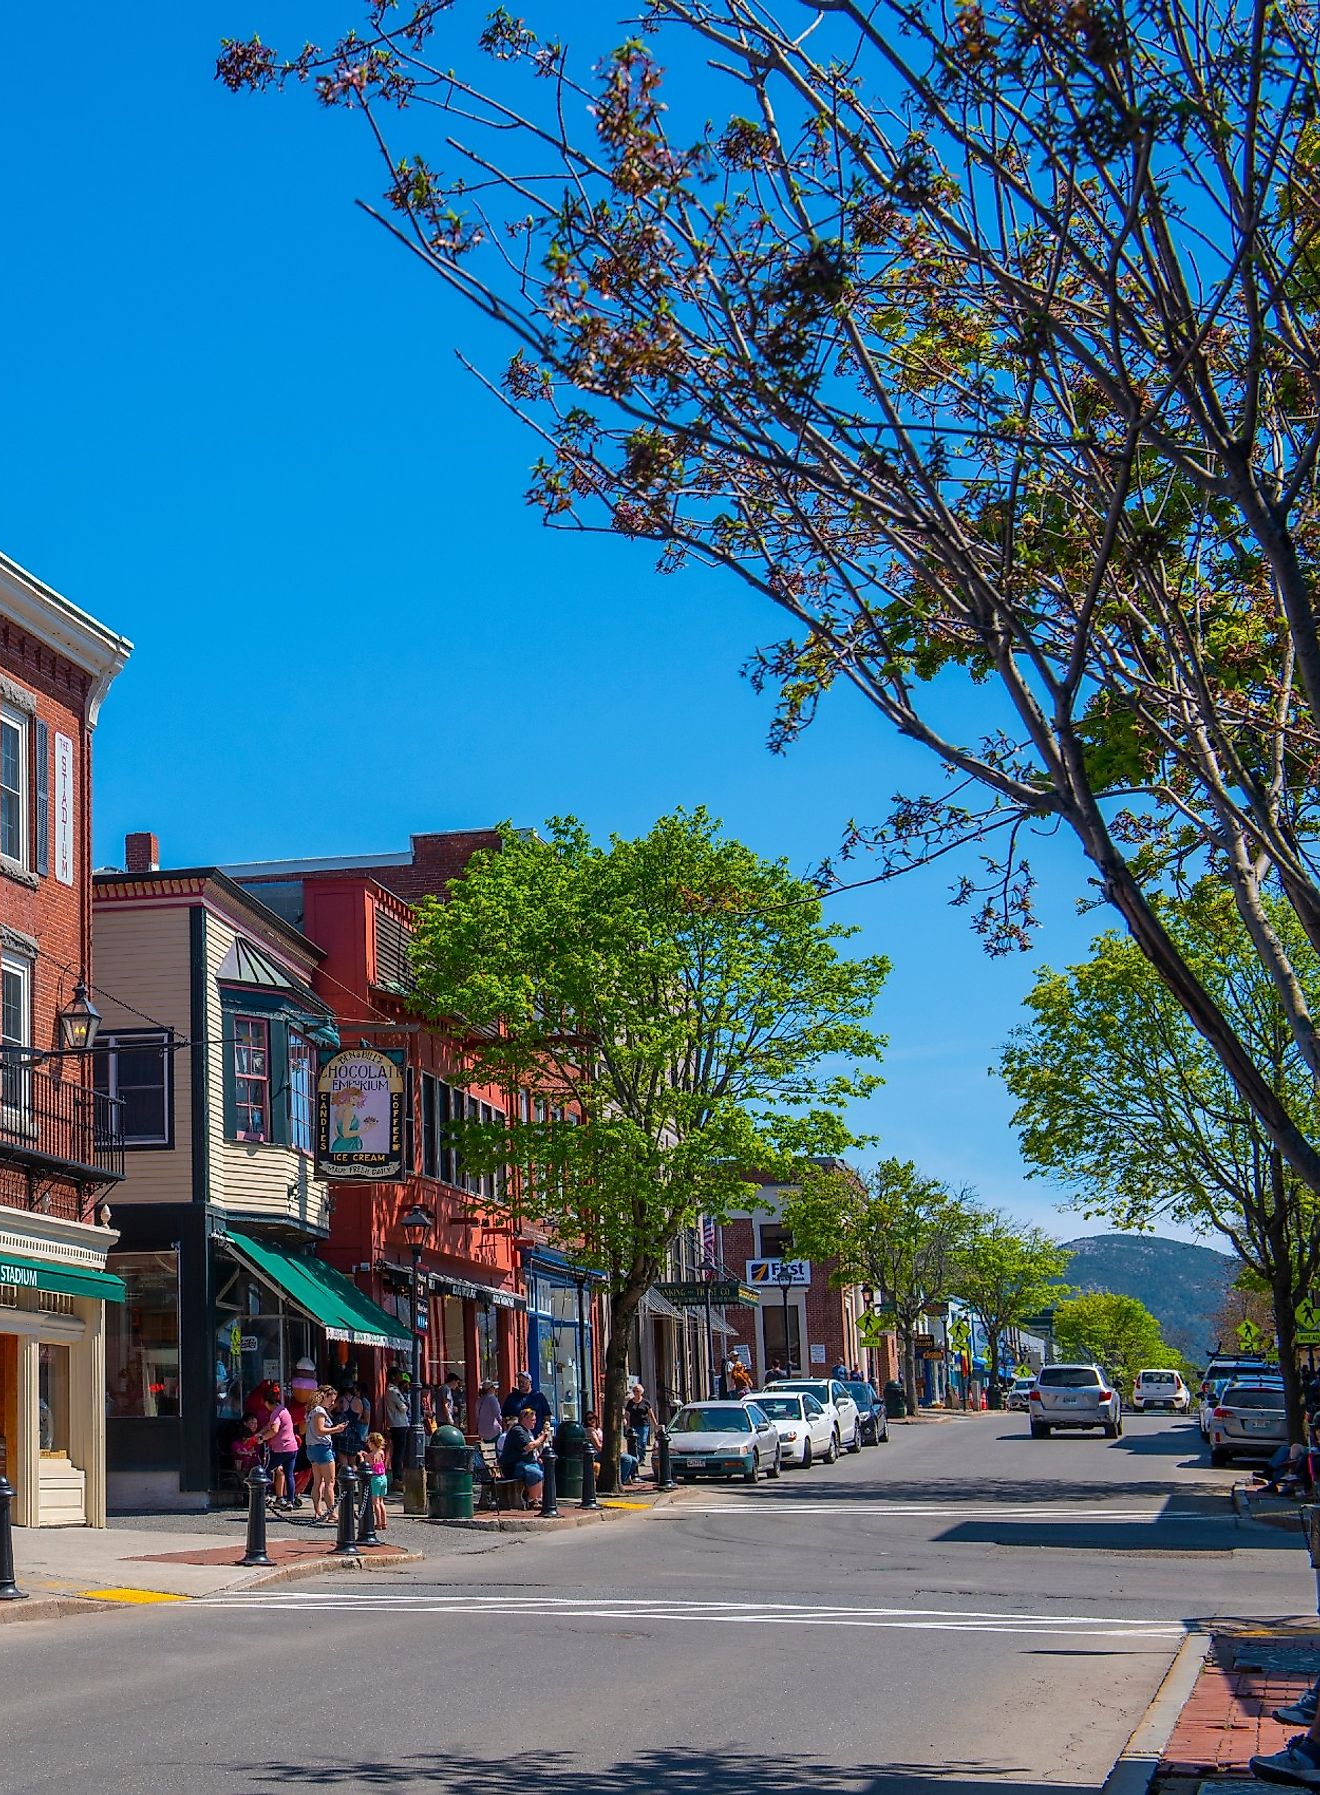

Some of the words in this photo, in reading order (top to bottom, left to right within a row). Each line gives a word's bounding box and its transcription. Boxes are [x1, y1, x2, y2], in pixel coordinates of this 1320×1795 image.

[320, 1094, 328, 1150] CANDIES
[392, 1094, 400, 1143] COFFEE
[333, 1153, 348, 1161] ICE
[352, 1153, 386, 1162] CREAM
[0, 1265, 38, 1287] STADIUM
[696, 1287, 717, 1297] TRST
